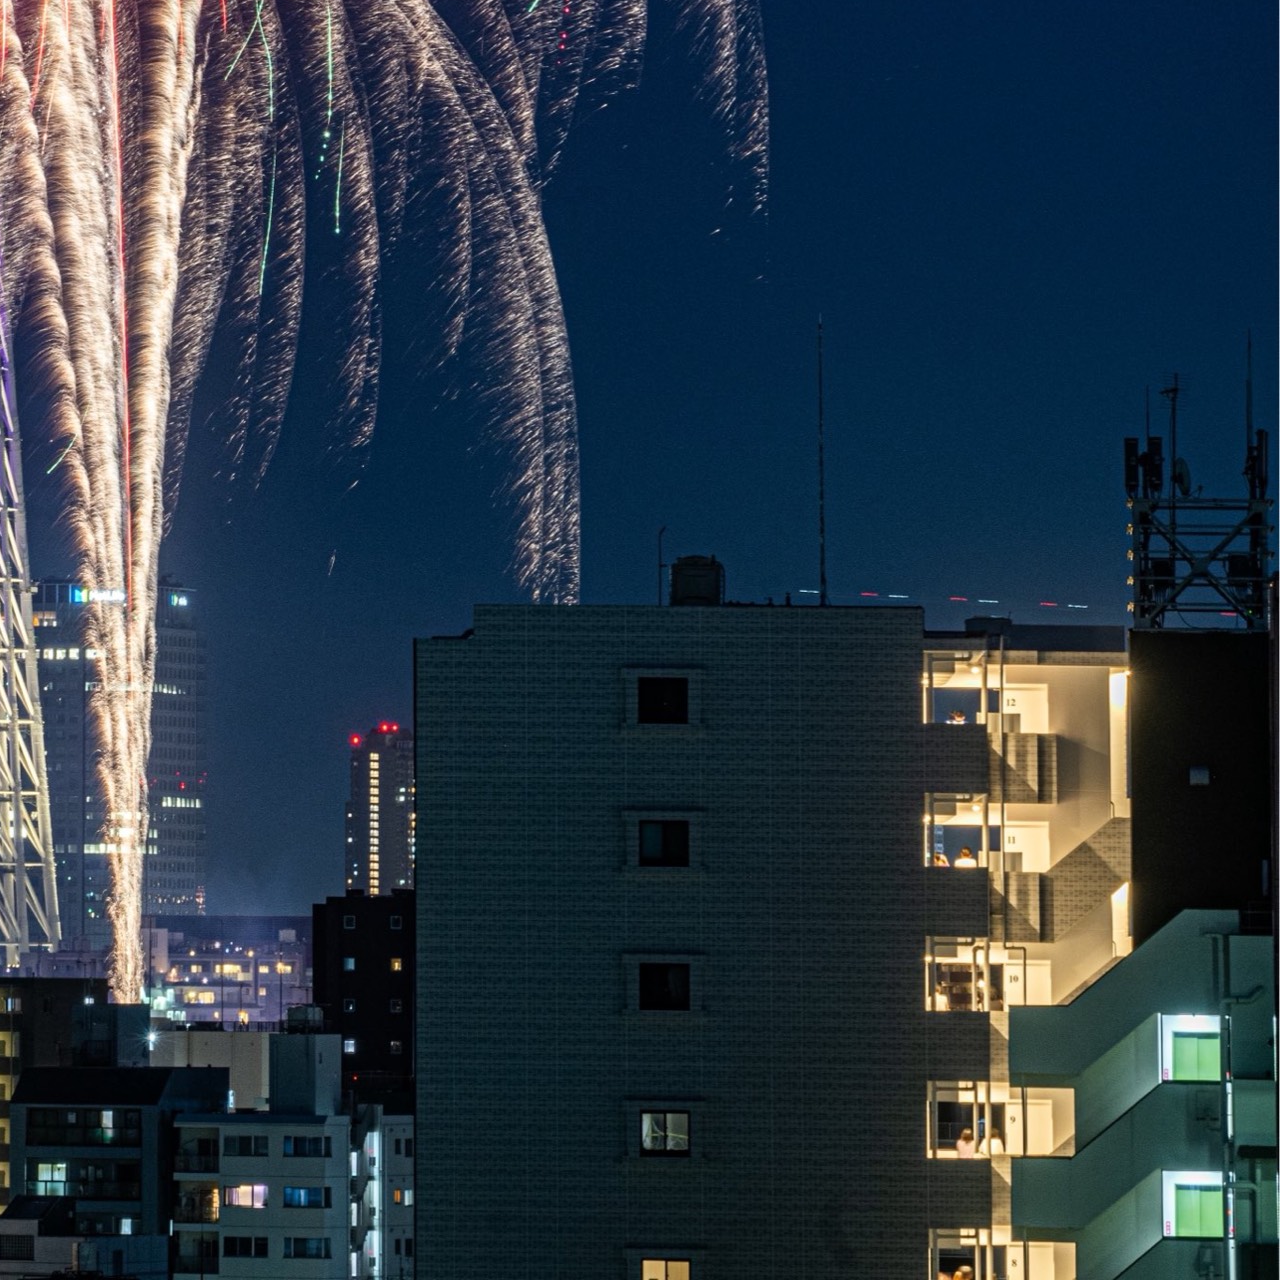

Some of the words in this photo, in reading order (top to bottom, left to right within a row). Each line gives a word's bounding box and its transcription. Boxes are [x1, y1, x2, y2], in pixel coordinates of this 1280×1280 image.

[1006, 698, 1016, 707] 12
[1007, 836, 1016, 844] 11
[1009, 974, 1019, 983] 10
[1010, 1115, 1016, 1124] 9
[1011, 1259, 1018, 1267] 8
